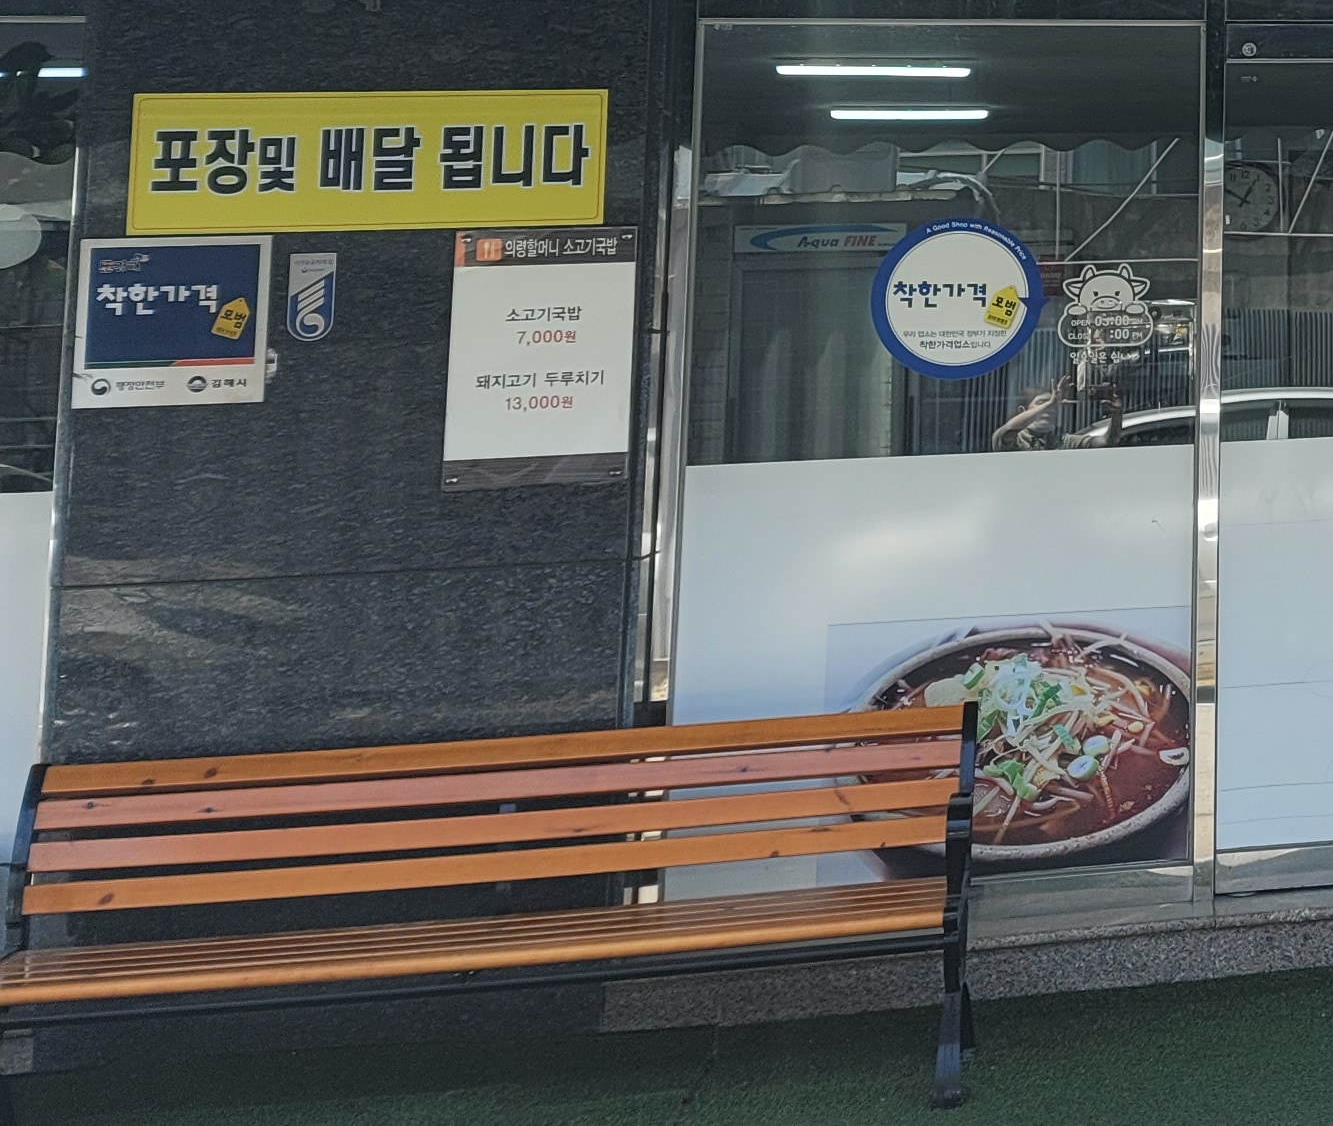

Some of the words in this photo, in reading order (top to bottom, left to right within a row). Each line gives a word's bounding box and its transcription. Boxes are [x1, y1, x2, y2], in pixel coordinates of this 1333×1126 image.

[150, 127, 297, 194] 포장및
[319, 125, 422, 192] 배달
[439, 123, 590, 190] 됩니다
[504, 239, 559, 258] 의령할머니
[562, 237, 618, 257] 소고기국밥
[797, 235, 839, 249] Aqua
[843, 235, 877, 247] FINE
[932, 222, 950, 231] Good
[1014, 245, 1027, 260] Price
[96, 283, 219, 316] 착한가격
[893, 281, 987, 308] 착한가격
[505, 306, 582, 322] 소고기국밥
[992, 296, 1017, 317] 모범
[220, 308, 248, 328] 모범
[1071, 319, 1091, 327] OPEN
[516, 329, 577, 346] 7,000원
[1068, 332, 1090, 340] CLOS
[211, 378, 247, 389] 김해시
[475, 373, 536, 390] 돼지고기
[544, 370, 605, 387] 두루치기
[505, 395, 574, 412] 13,000원
